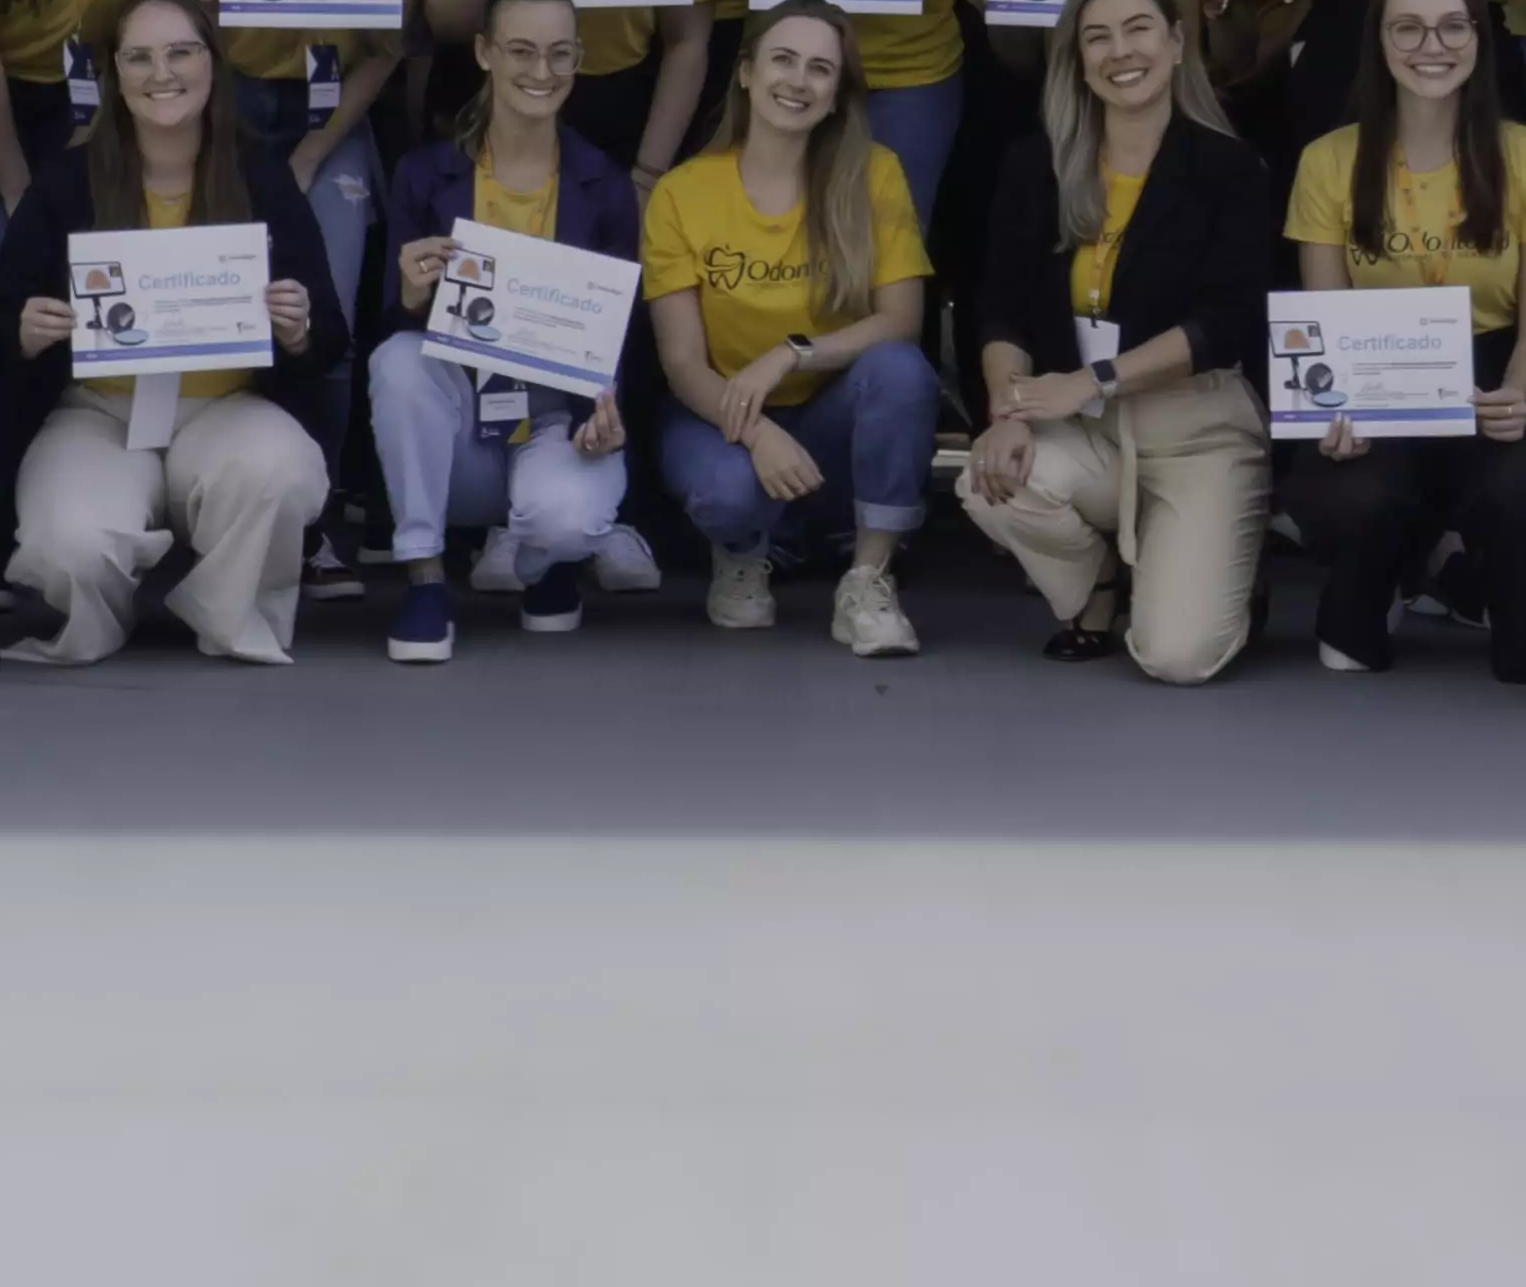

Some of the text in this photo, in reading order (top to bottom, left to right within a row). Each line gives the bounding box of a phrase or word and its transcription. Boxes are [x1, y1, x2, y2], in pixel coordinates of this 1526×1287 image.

[138, 270, 242, 291] Certificado
[506, 277, 604, 315] Certificado
[1337, 334, 1442, 352] Certificado
